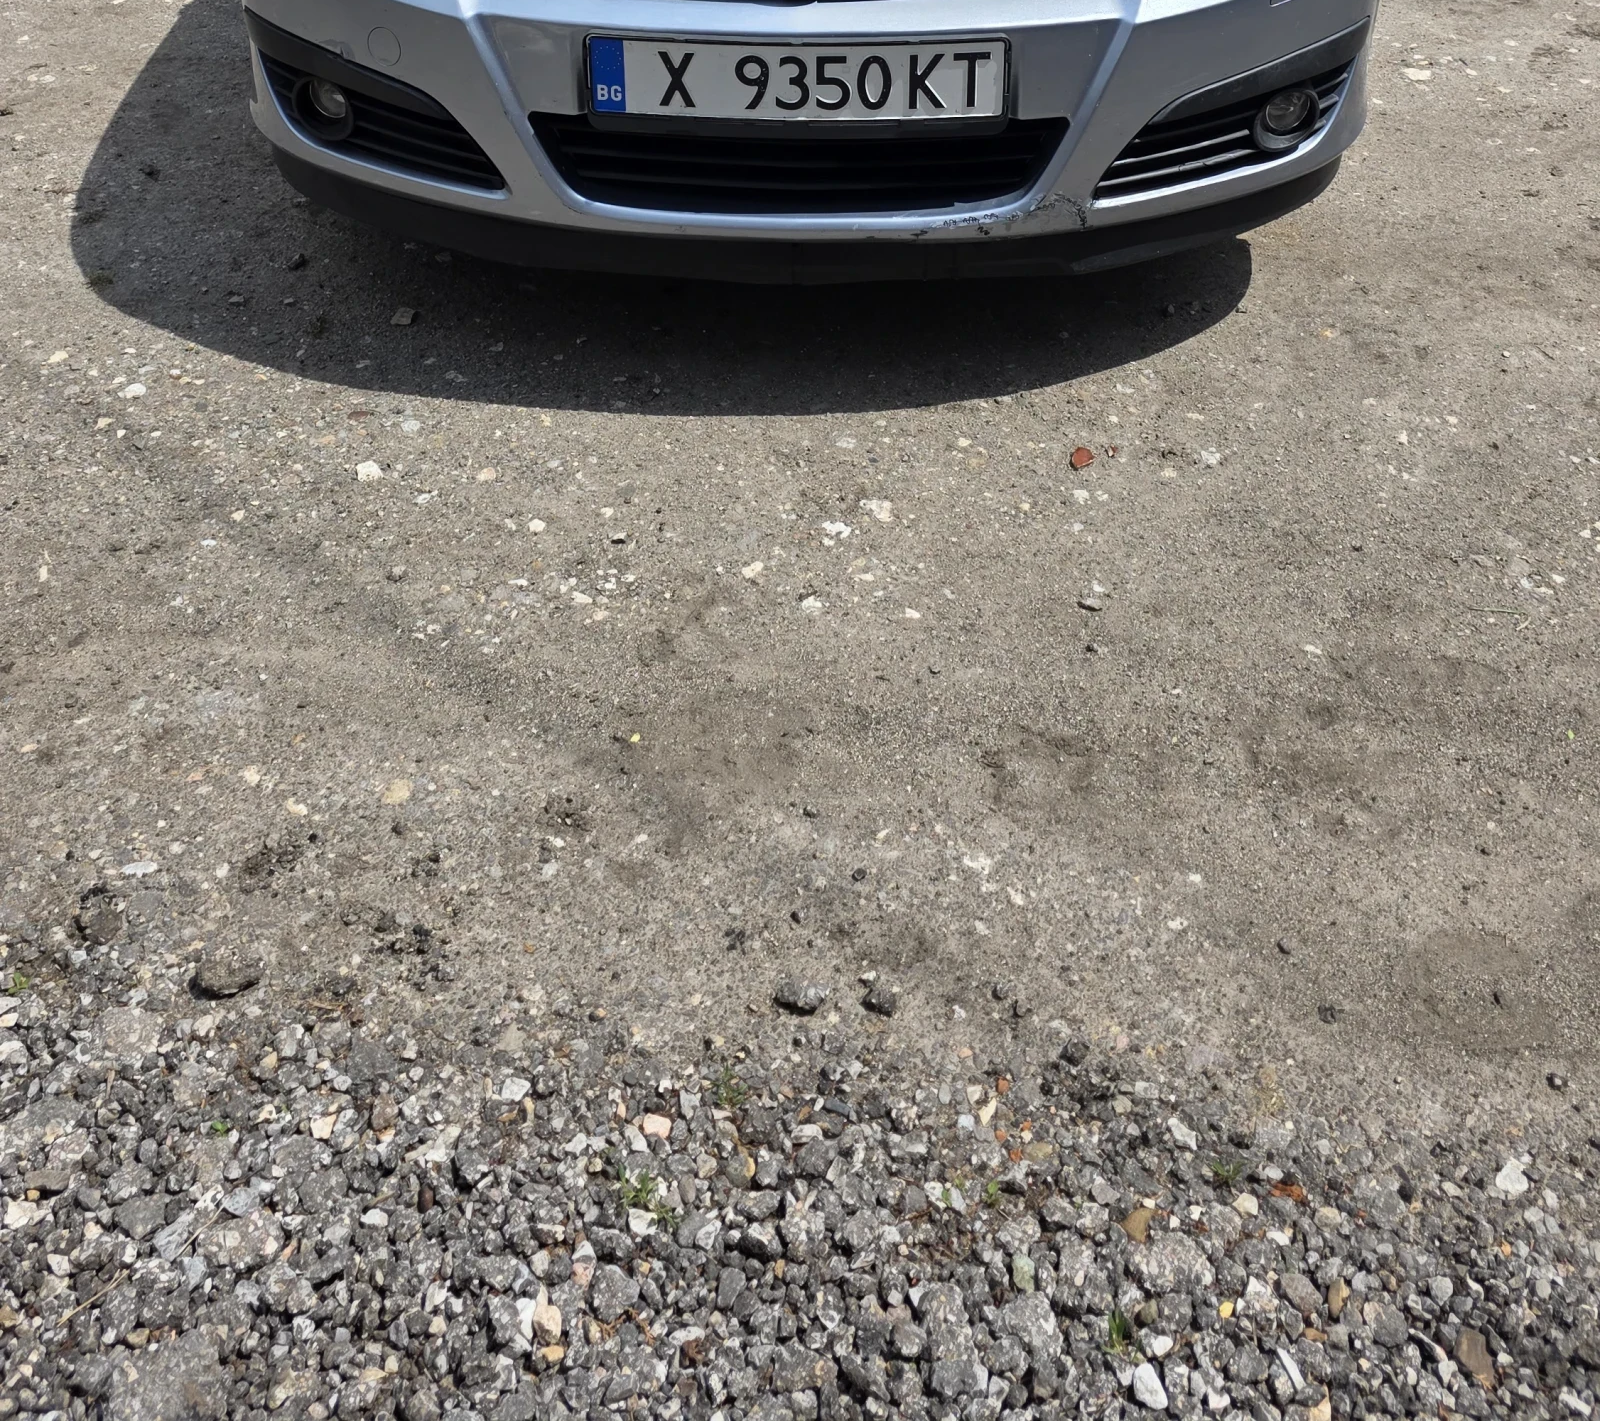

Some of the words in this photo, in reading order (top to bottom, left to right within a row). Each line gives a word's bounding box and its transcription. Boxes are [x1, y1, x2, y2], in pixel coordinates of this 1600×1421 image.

[596, 84, 622, 101] BG
[657, 50, 696, 108] X
[734, 53, 892, 111] 9350
